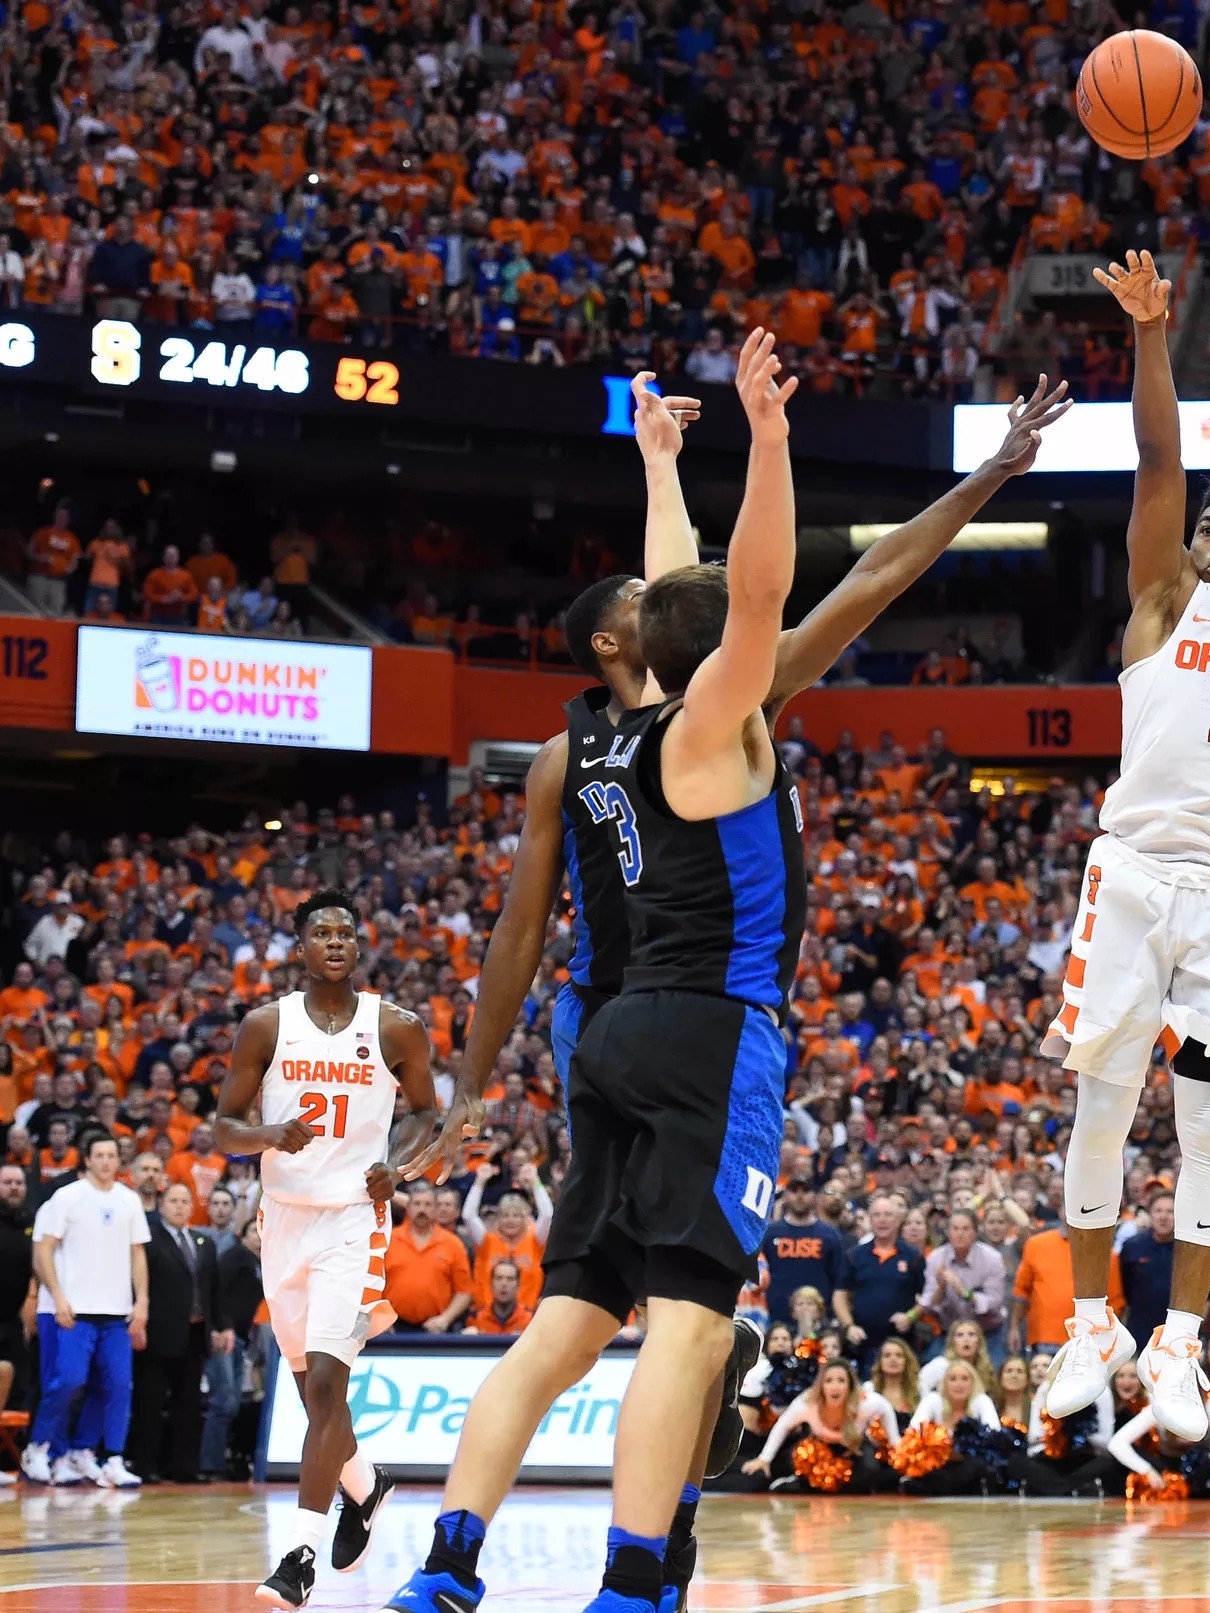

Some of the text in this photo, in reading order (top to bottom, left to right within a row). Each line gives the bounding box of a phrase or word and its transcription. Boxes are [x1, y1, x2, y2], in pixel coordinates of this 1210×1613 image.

[91, 319, 141, 386] S
[334, 357, 400, 405] 52
[1, 635, 48, 680] 112
[188, 658, 328, 690] DUNKIN'
[187, 687, 319, 721] DONUTS
[583, 735, 595, 745] KB
[1027, 708, 1072, 747] 113
[604, 781, 644, 887] 3
[281, 1059, 375, 1086] ORANGE
[298, 1091, 349, 1139] 21
[741, 1164, 773, 1220] D
